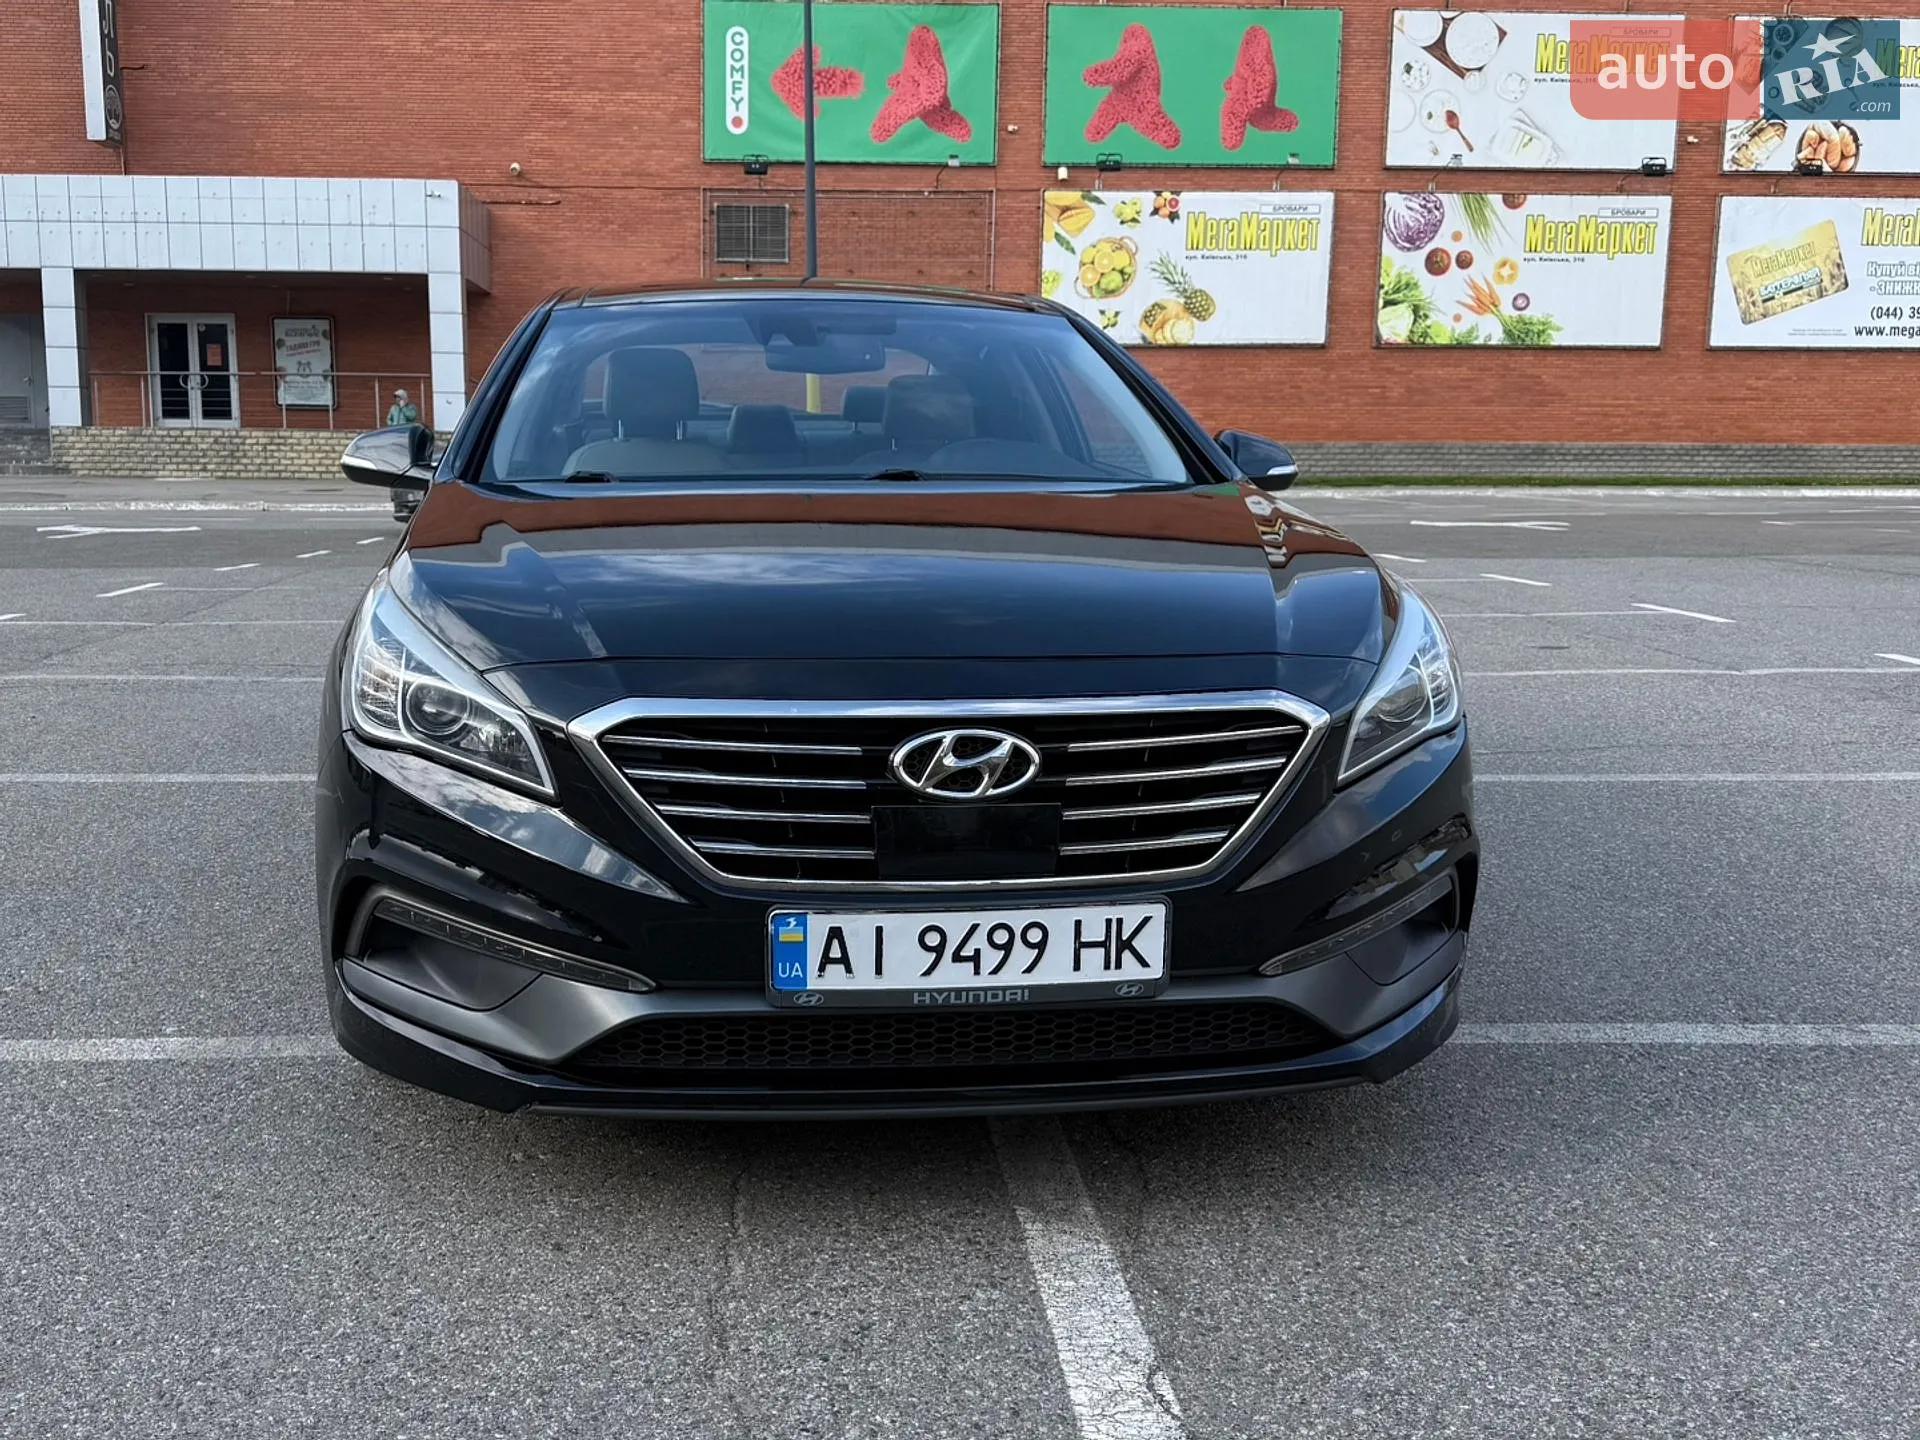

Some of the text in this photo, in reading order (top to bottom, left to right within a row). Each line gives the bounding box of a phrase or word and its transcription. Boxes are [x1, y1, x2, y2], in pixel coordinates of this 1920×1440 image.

[730, 31, 745, 112] COMFY
[1186, 211, 1321, 257] МегаМаркет
[1524, 214, 1658, 260] МегаМаркет
[1751, 241, 1816, 278] МегаМаркет
[1866, 260, 1906, 278] Купуй
[1870, 306, 1903, 320] (044)
[816, 915, 1153, 978] AI 9499 HK
[778, 962, 803, 978] UA
[913, 988, 1031, 1005] HYUNDAI
